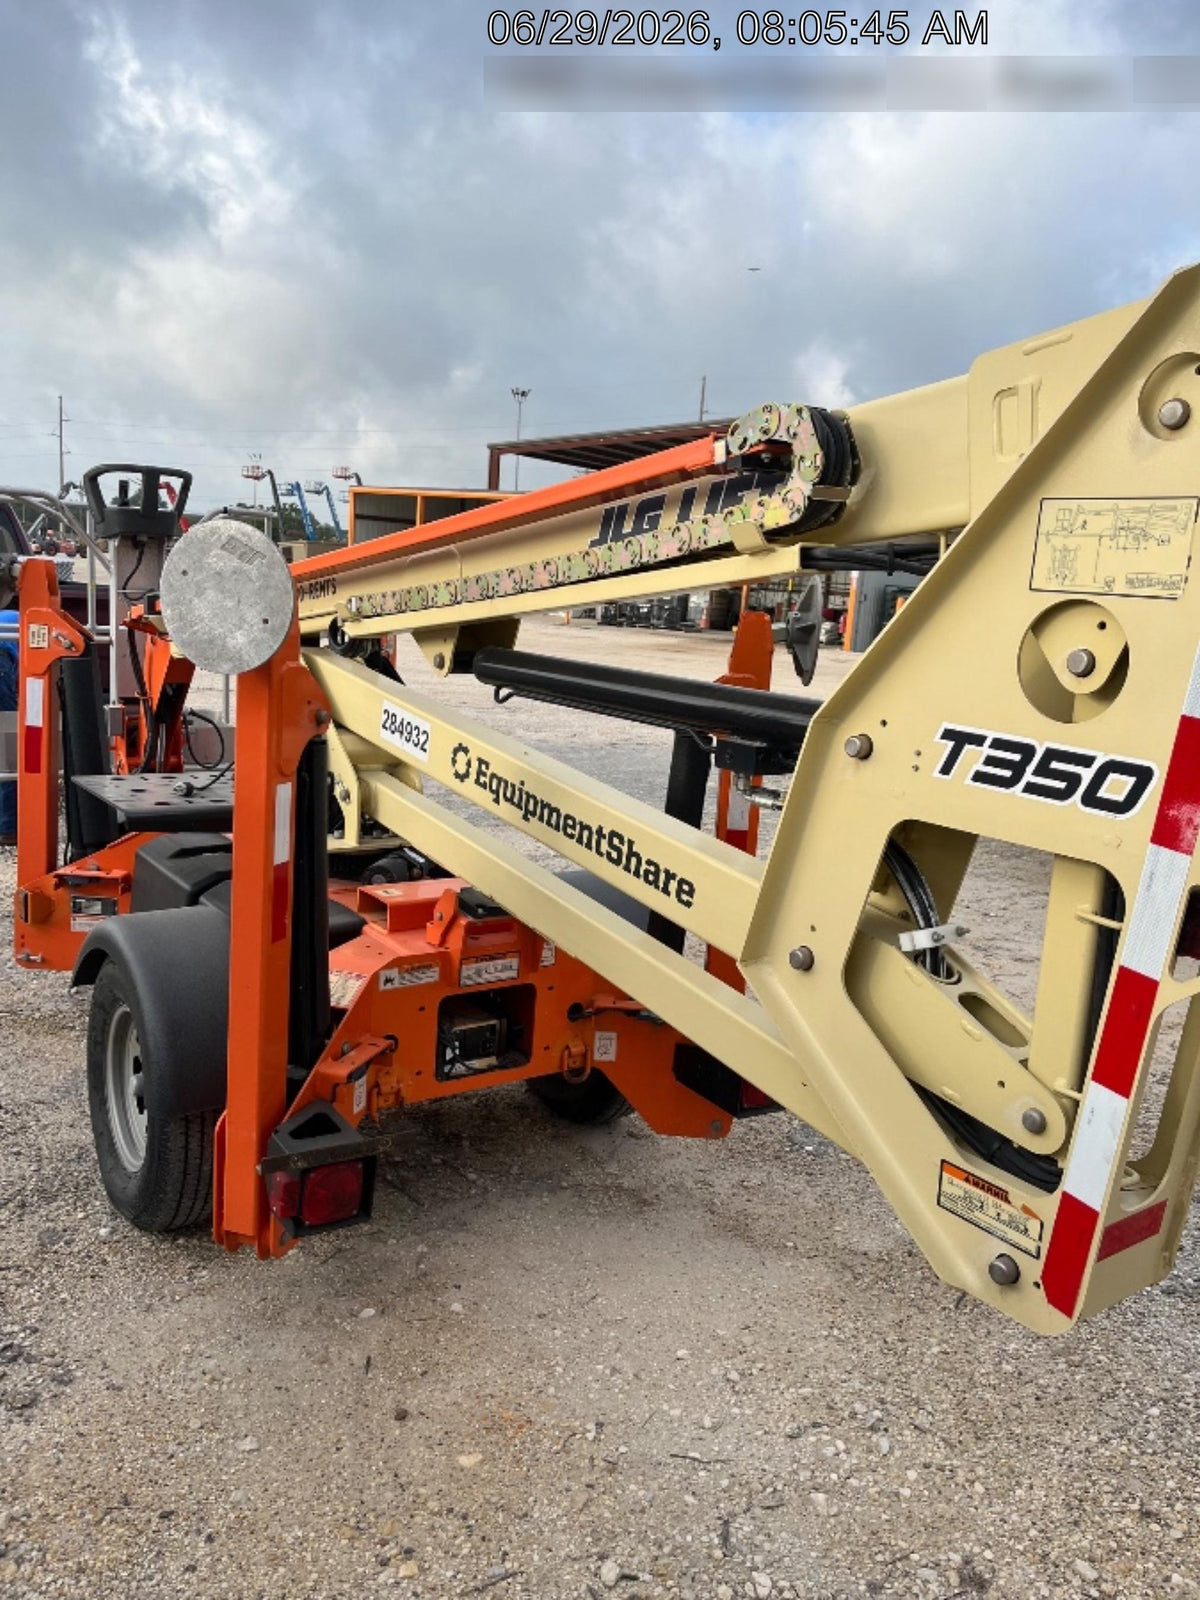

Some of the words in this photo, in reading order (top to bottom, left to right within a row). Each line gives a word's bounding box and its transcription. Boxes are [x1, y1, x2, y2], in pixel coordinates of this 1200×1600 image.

[589, 494, 667, 548] JLG
[381, 709, 429, 753] 284932
[938, 727, 1155, 815] T350
[475, 756, 697, 909] EquipmentShare
